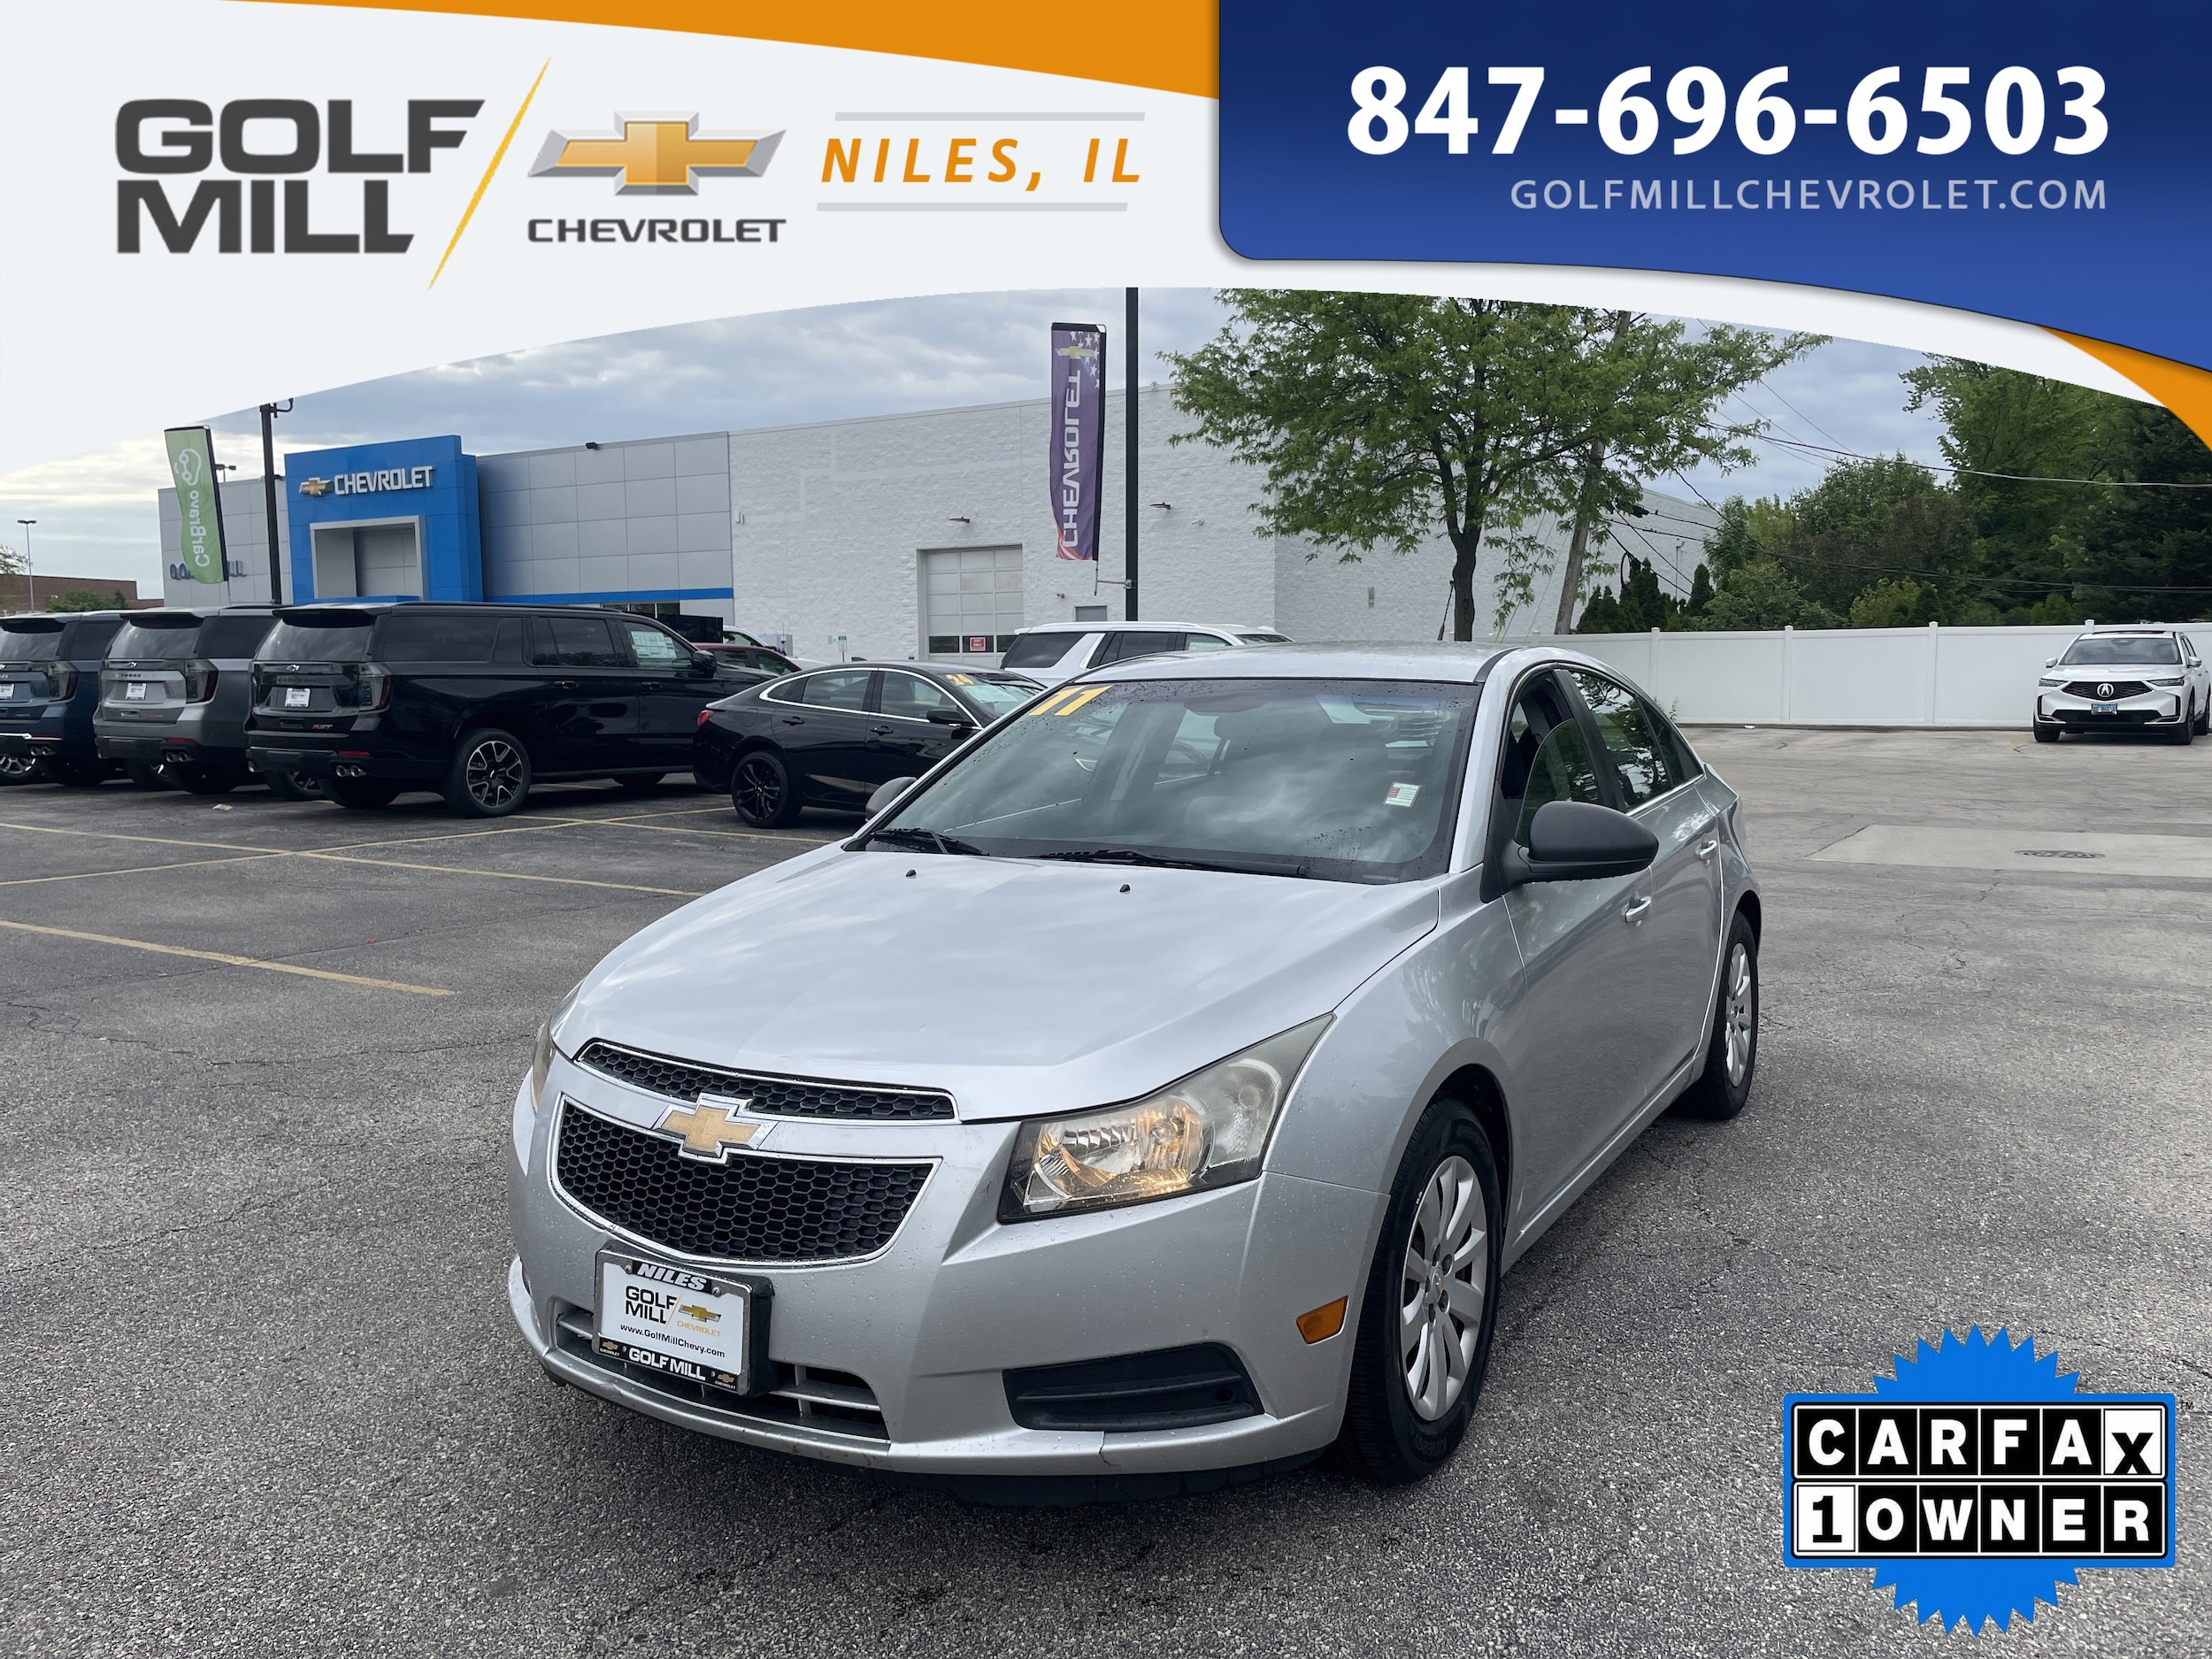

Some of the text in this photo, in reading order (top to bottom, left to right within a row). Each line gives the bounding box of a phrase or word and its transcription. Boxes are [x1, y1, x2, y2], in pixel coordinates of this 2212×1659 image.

[334, 465, 434, 495] CHEVROLET
[945, 673, 974, 686] 24
[1028, 685, 1113, 716] 11
[637, 1263, 707, 1291] NILES
[626, 1286, 678, 1310] GOLF
[626, 1301, 667, 1325] MILL
[620, 1324, 726, 1358] www.GolfMillChevy.com
[677, 1320, 722, 1337] CHEVROLET
[628, 1348, 706, 1381] GOLF MILL
